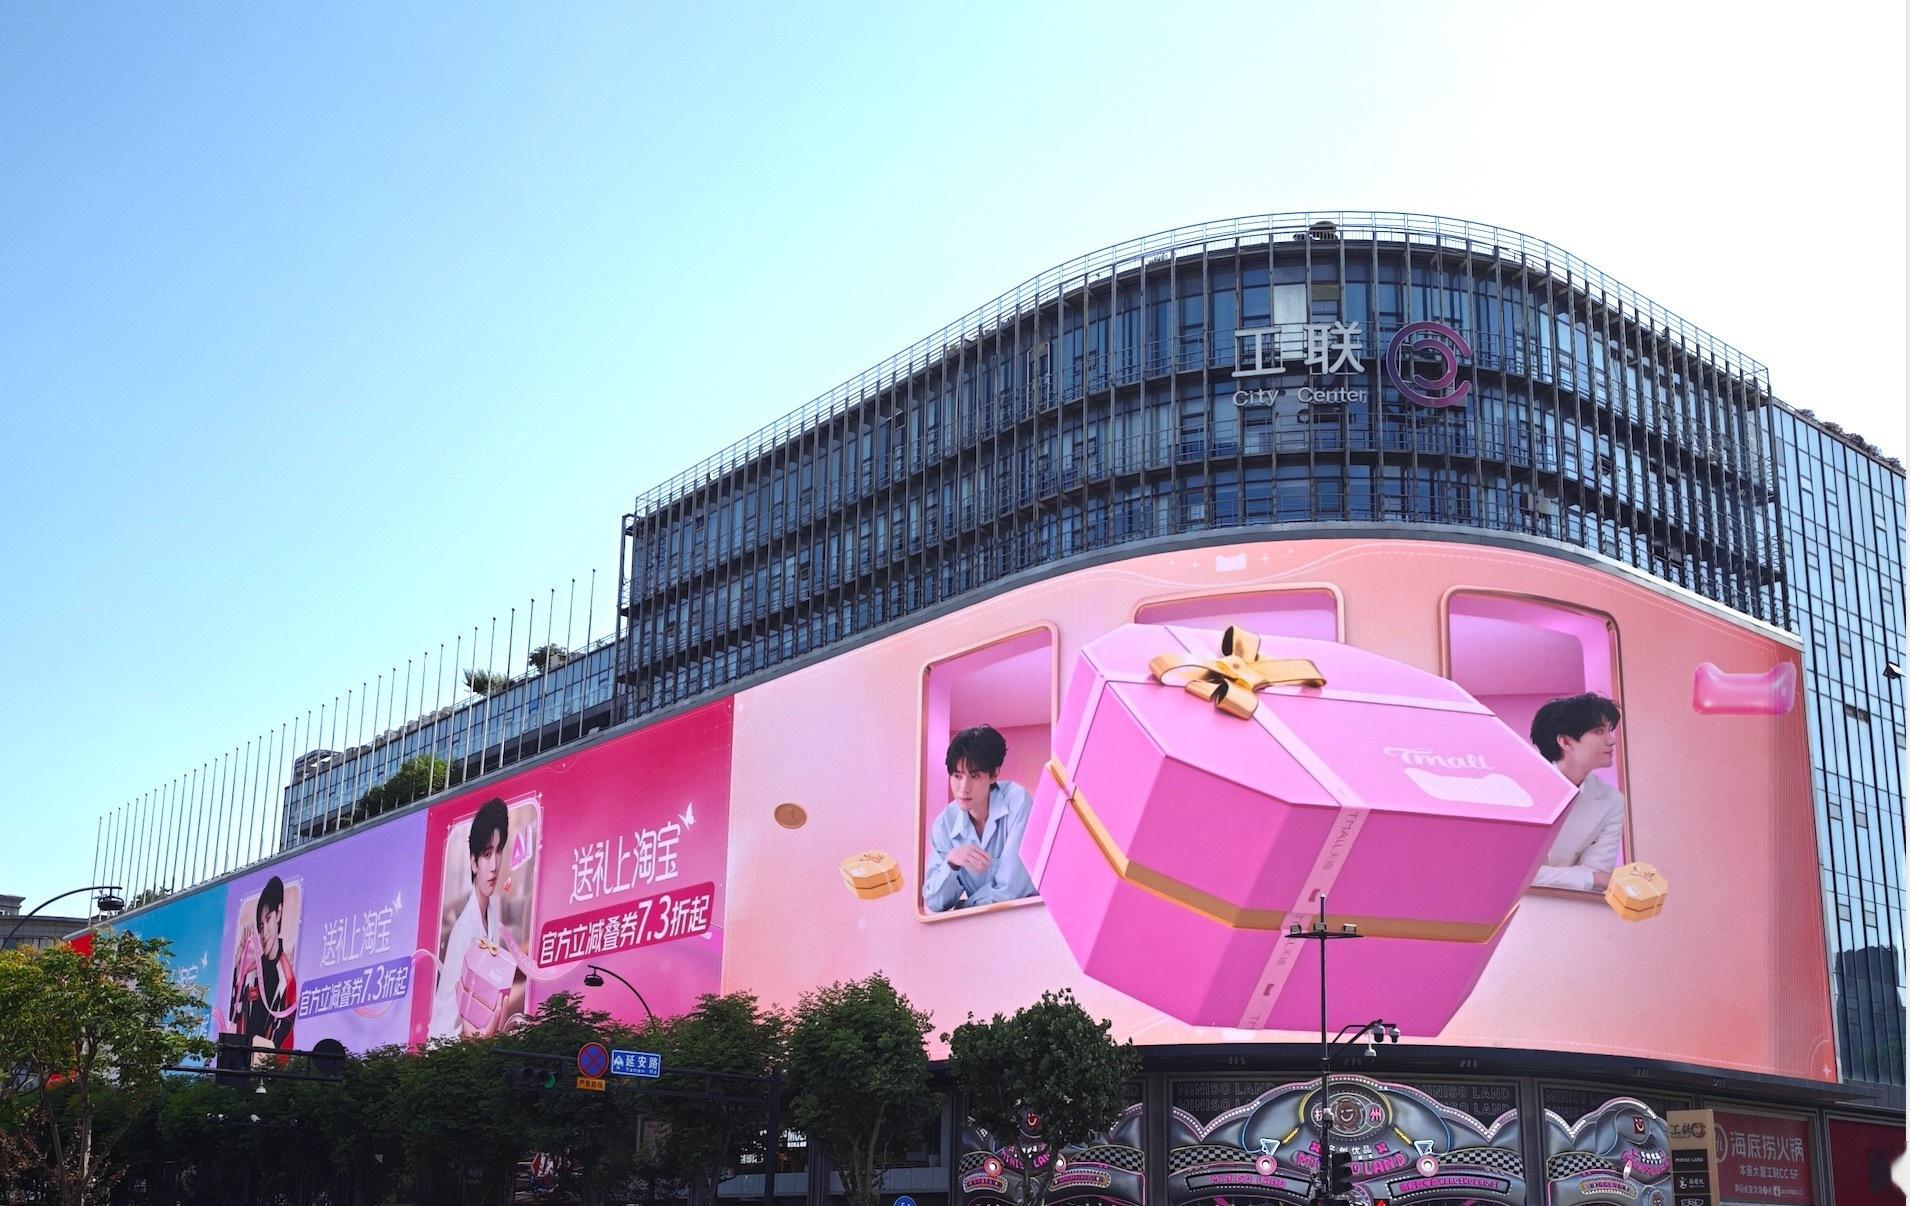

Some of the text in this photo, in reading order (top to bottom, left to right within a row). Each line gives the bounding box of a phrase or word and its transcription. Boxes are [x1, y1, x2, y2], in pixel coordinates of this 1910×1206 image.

[1231, 320, 1365, 378] 工联
[1232, 386, 1367, 407] City Center
[1382, 746, 1495, 771] Tmall
[569, 820, 681, 904] 送礼上淘宝
[320, 905, 395, 968] 送礼上淘宝
[539, 894, 710, 966] 官方立减叠券7.3折起
[300, 966, 409, 1017] 官方立减叠券7.3折起
[625, 1054, 658, 1070] 延安路
[1176, 1082, 1230, 1096] MINISO
[1472, 1086, 1511, 1100] LAND
[1730, 1131, 1805, 1163] 海底捞火锅
[1363, 1153, 1406, 1175] LAND
[1210, 1173, 1253, 1185] MINISO
